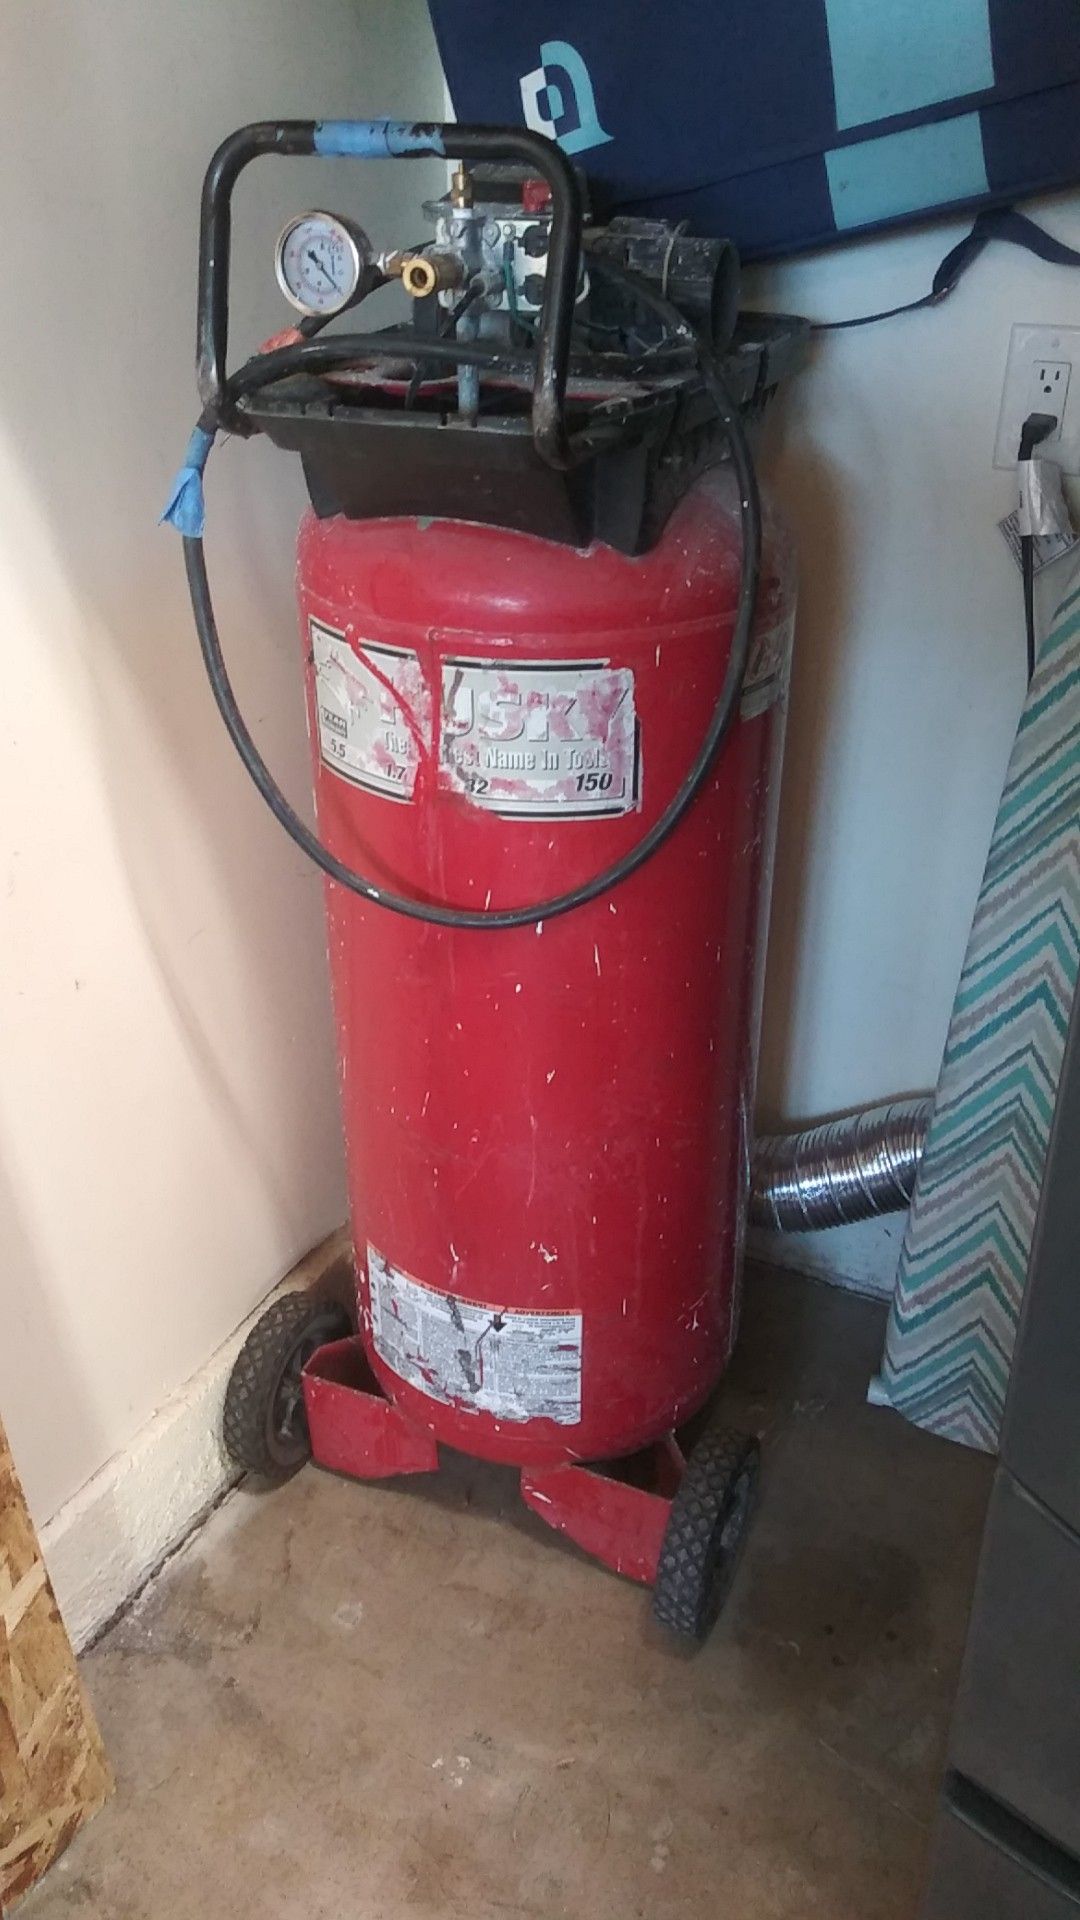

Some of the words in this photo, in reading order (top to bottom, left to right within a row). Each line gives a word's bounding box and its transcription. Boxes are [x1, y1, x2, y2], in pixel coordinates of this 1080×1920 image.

[379, 684, 630, 743] USKY
[331, 739, 346, 759] 5.5
[486, 749, 536, 771] Name
[543, 749, 559, 771] In
[387, 763, 407, 780] 1.7
[575, 772, 614, 793] 150
